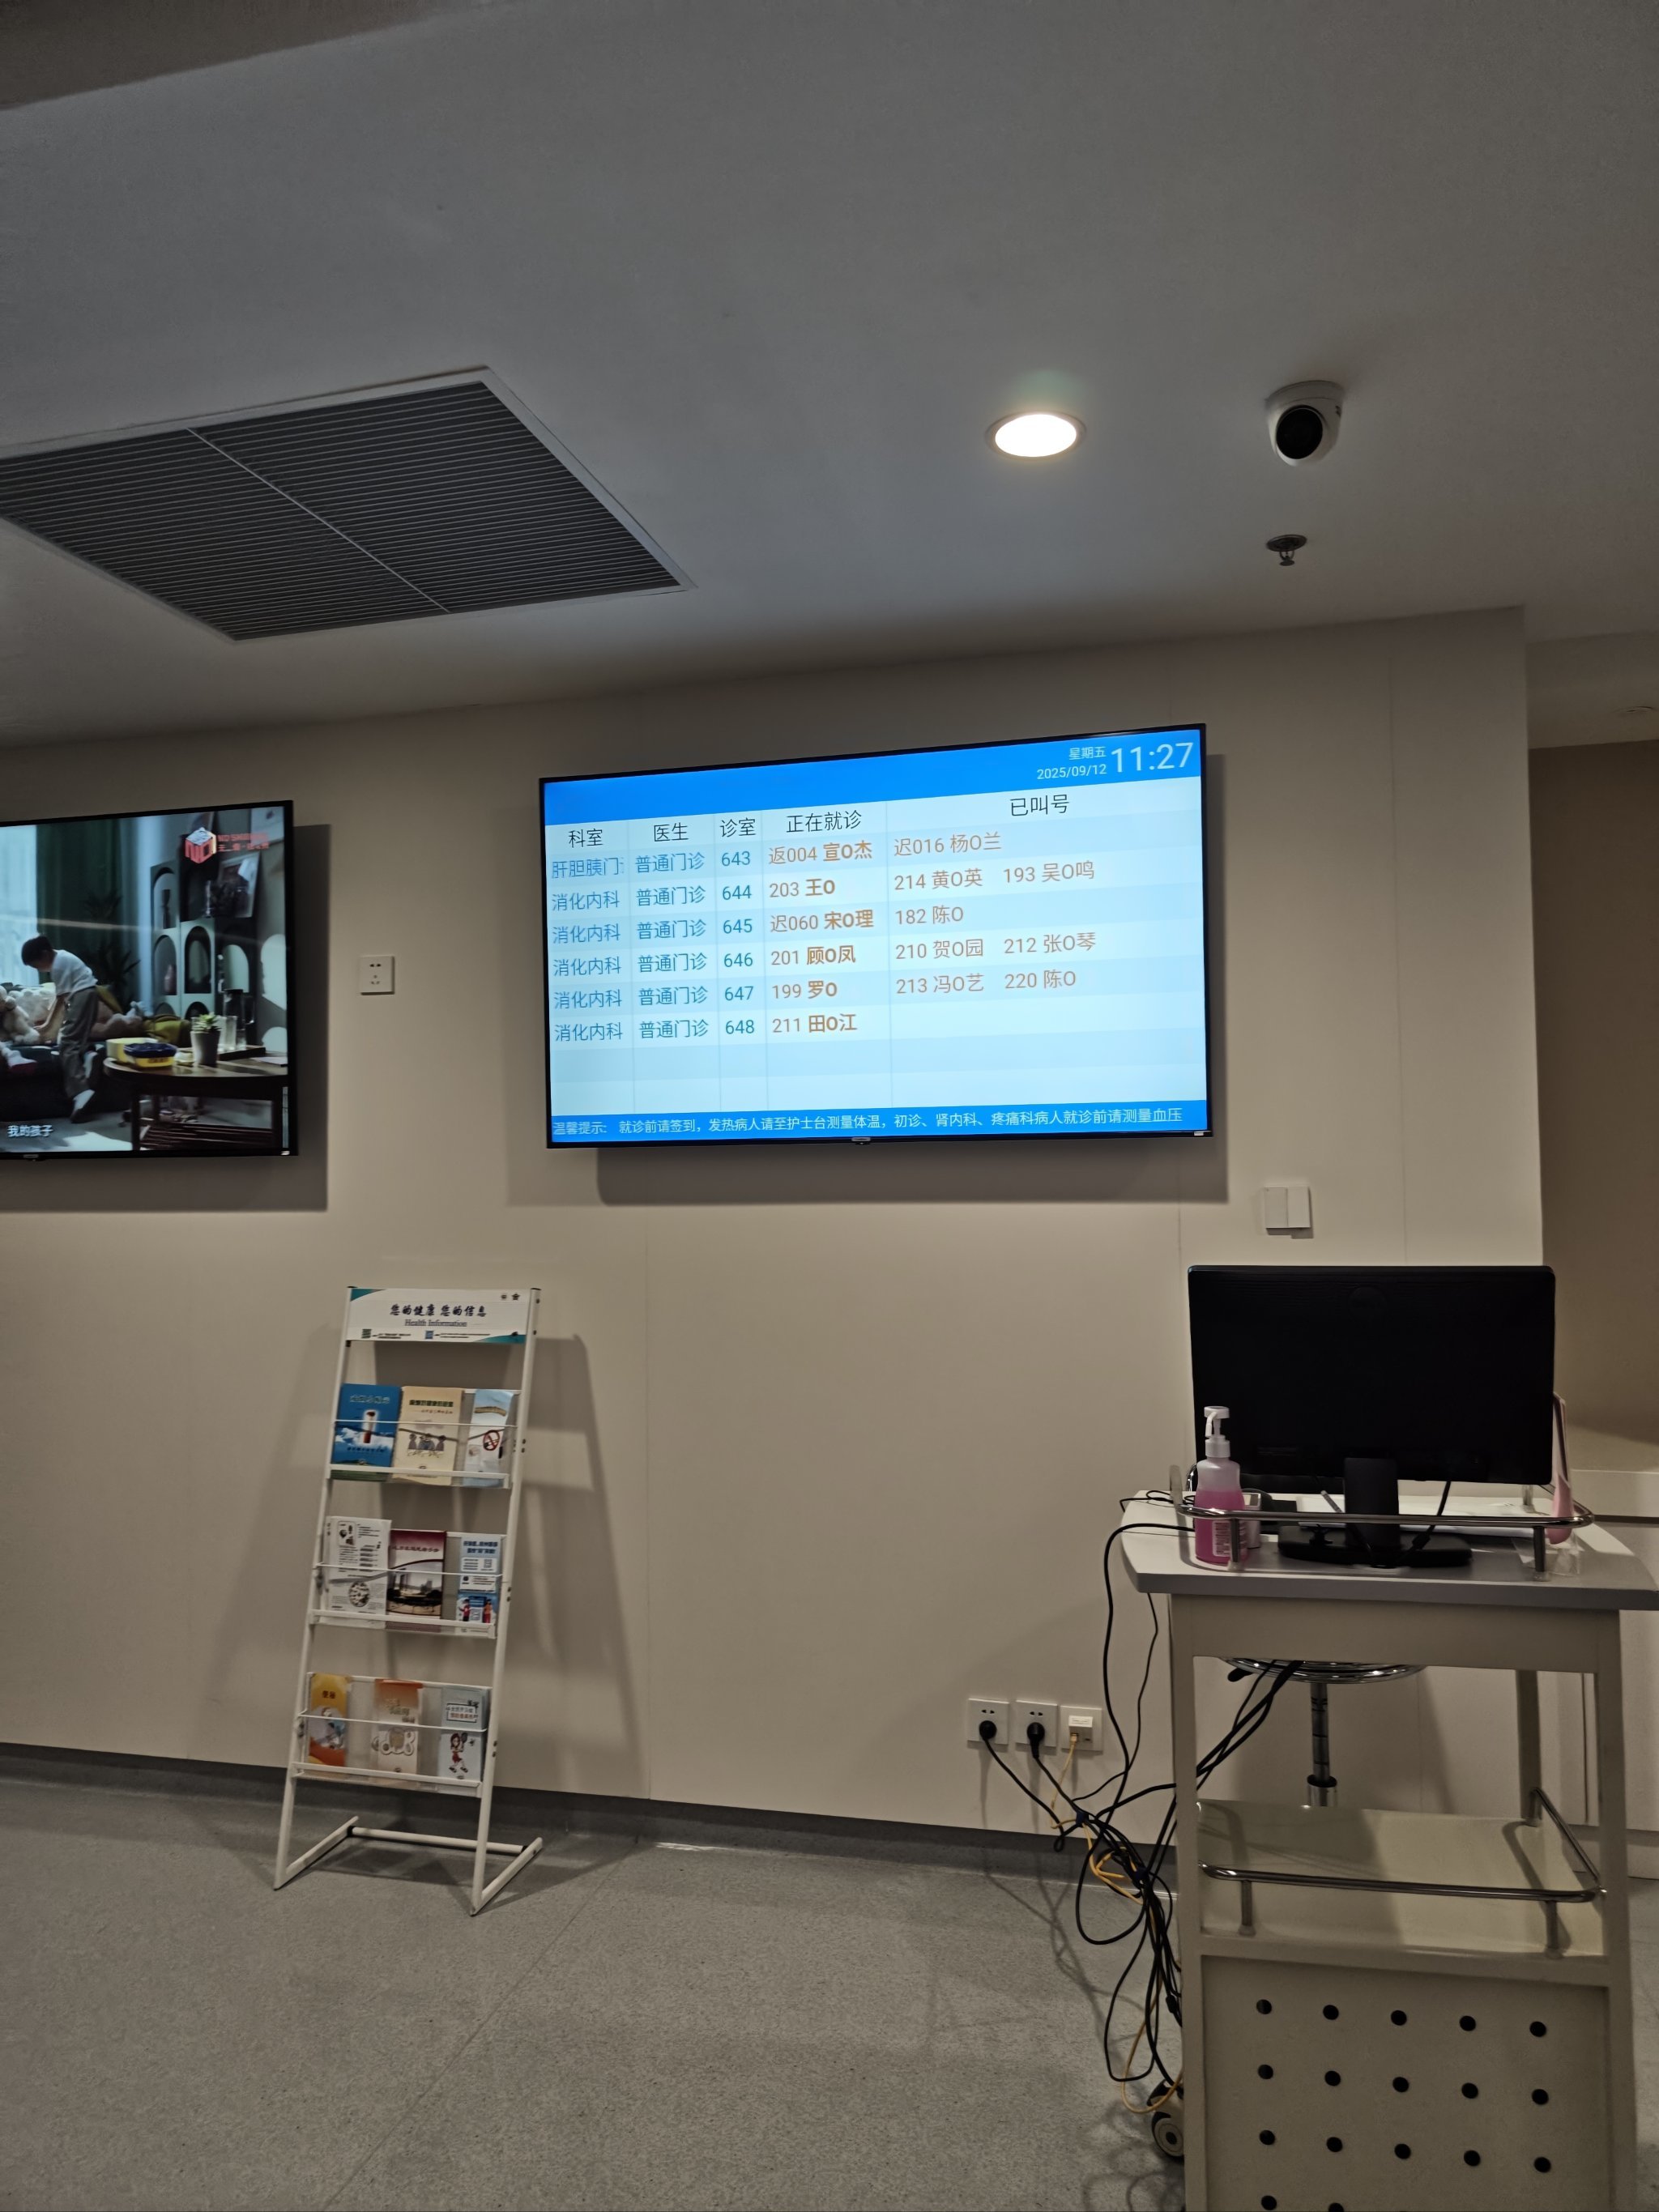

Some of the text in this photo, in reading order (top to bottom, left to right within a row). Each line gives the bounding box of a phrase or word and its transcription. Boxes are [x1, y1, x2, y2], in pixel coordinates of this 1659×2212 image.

[1069, 747, 1106, 760] 星期五
[1111, 743, 1193, 773] 11:27
[1037, 764, 1107, 779] 2025/09/12
[1010, 795, 1069, 816] 已叫号
[720, 817, 756, 837] 诊室
[787, 810, 861, 833] 正在就诊
[569, 829, 603, 848] 科室
[654, 822, 689, 842] 医生
[894, 838, 944, 856] 迟016
[635, 852, 705, 873] 普通门诊
[722, 851, 750, 866] 643
[769, 846, 817, 865] 返004
[894, 874, 926, 889] 214
[1004, 867, 1034, 883] 193
[636, 885, 706, 906] 普通门诊
[723, 885, 752, 900] 644
[770, 882, 799, 897] 203
[552, 890, 620, 911] 消化内科
[771, 915, 817, 932] 迟060
[896, 909, 927, 924] 182
[553, 923, 621, 944] 消化内科
[638, 919, 706, 940] 普通门诊
[723, 918, 752, 934] 645
[896, 944, 926, 959] 210
[1004, 938, 1037, 953] 212
[638, 953, 707, 973] 普通门诊
[724, 953, 753, 967] 646
[771, 951, 798, 965] 201
[554, 957, 621, 976] 消化内科
[897, 978, 927, 993] 213
[1005, 973, 1036, 988] 220
[555, 989, 622, 1008] 消化内科
[638, 986, 708, 1005] 普通门诊
[725, 986, 753, 1001] 647
[772, 984, 800, 999] 199
[556, 1022, 622, 1042] 消化内科
[639, 1019, 709, 1038] 普通门诊
[726, 1020, 754, 1034] 648
[773, 1018, 800, 1033] 211
[390, 1303, 487, 1318] 您的健康 您的信息
[405, 1319, 467, 1328] Health Information
